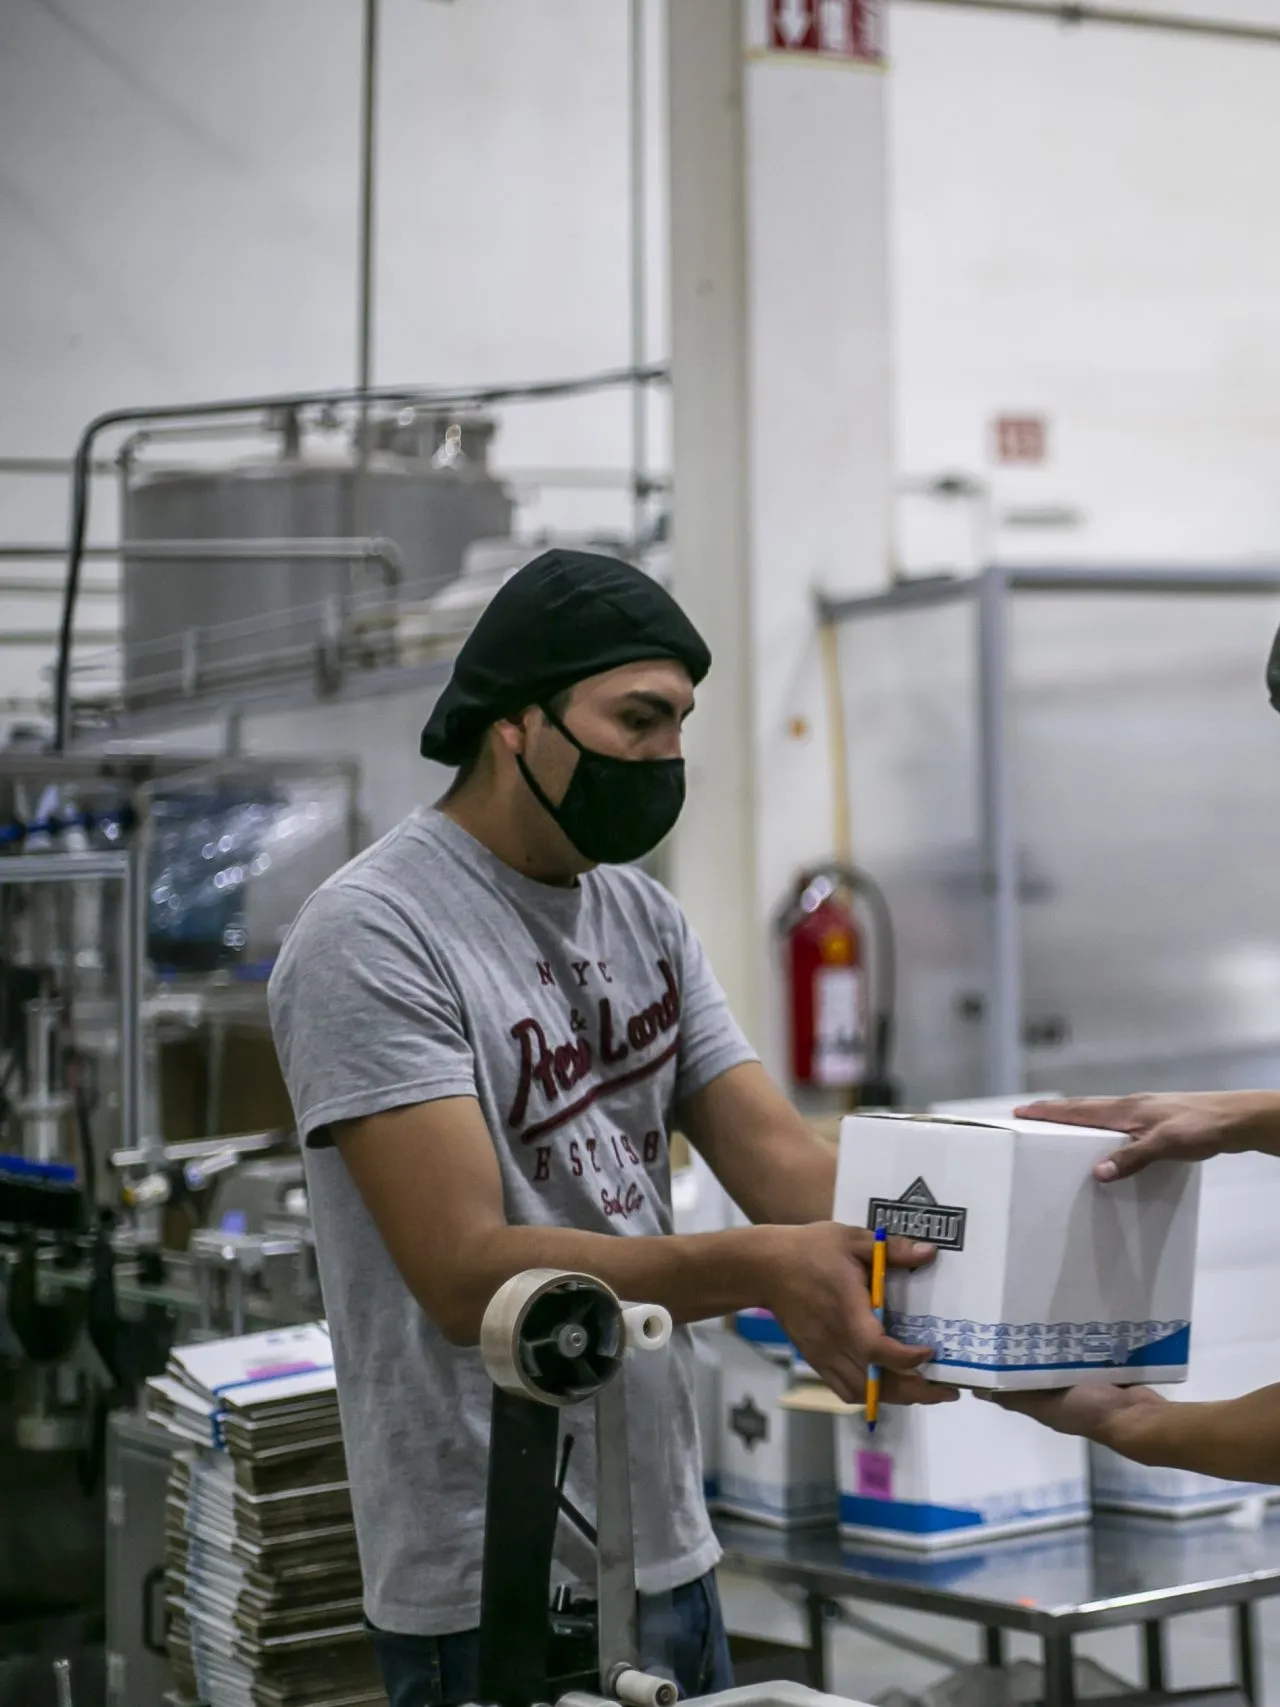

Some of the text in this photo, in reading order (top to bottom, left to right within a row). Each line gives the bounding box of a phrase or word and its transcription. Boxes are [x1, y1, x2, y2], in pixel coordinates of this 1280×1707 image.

[536, 960, 613, 986] NYC
[599, 959, 680, 1064] Land
[533, 1138, 601, 1181] EST
